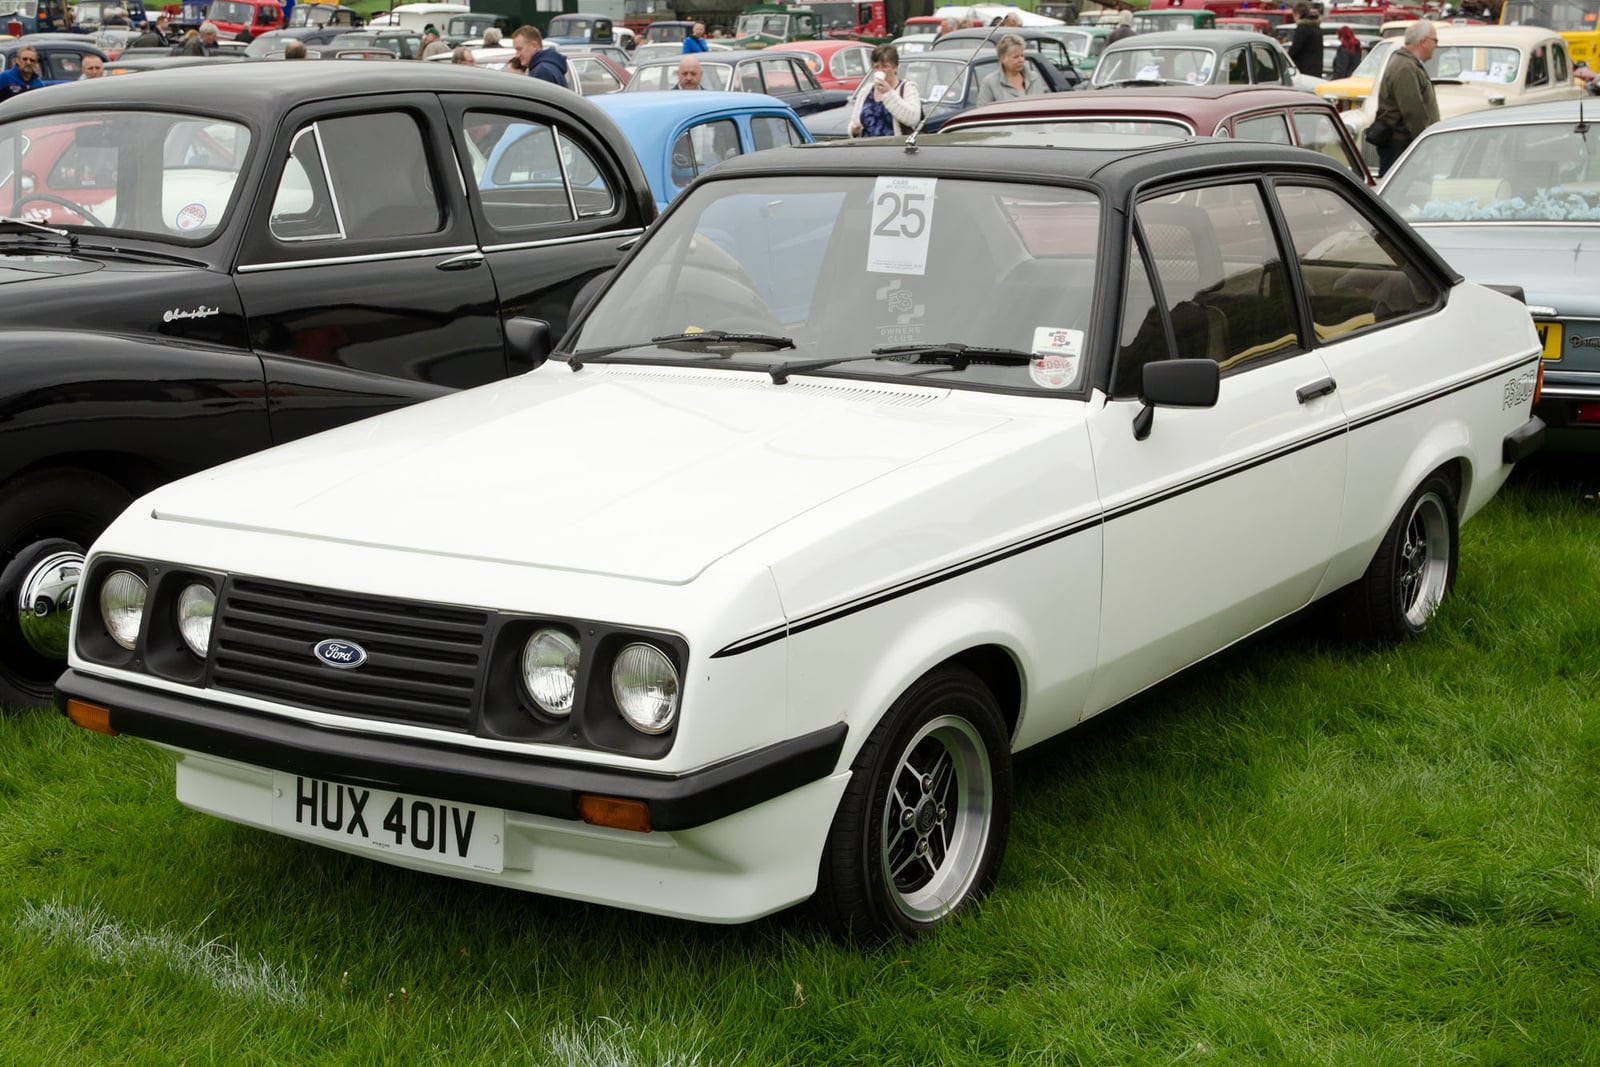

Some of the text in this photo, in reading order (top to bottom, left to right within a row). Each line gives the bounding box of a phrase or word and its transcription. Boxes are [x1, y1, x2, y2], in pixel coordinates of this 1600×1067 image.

[873, 191, 926, 239] 25
[325, 643, 354, 661] Ford
[296, 776, 477, 859] HUX 401V
